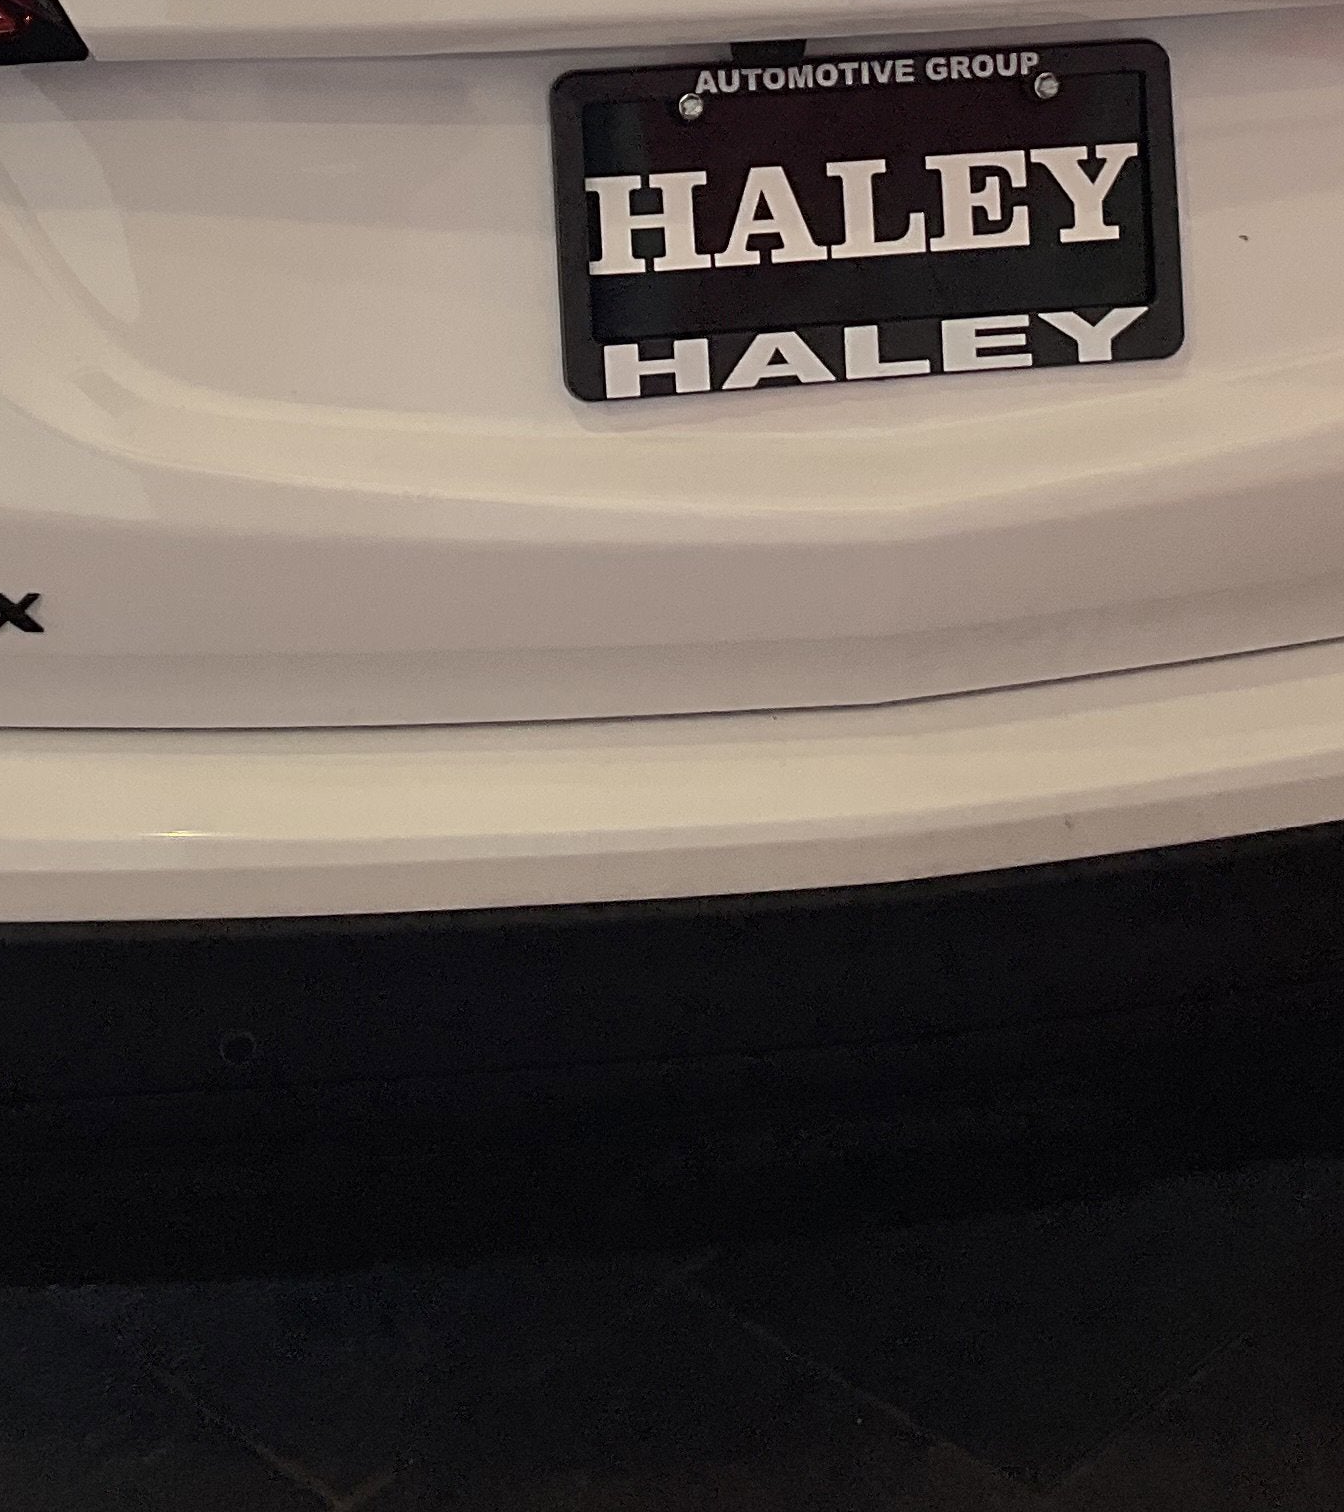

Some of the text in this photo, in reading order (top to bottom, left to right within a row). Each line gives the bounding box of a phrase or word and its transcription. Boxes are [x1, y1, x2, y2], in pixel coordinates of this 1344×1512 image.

[694, 50, 1042, 96] AUTOMOTIVE GROUP
[585, 141, 1140, 277] HALEY
[602, 305, 1150, 401] HALEY
